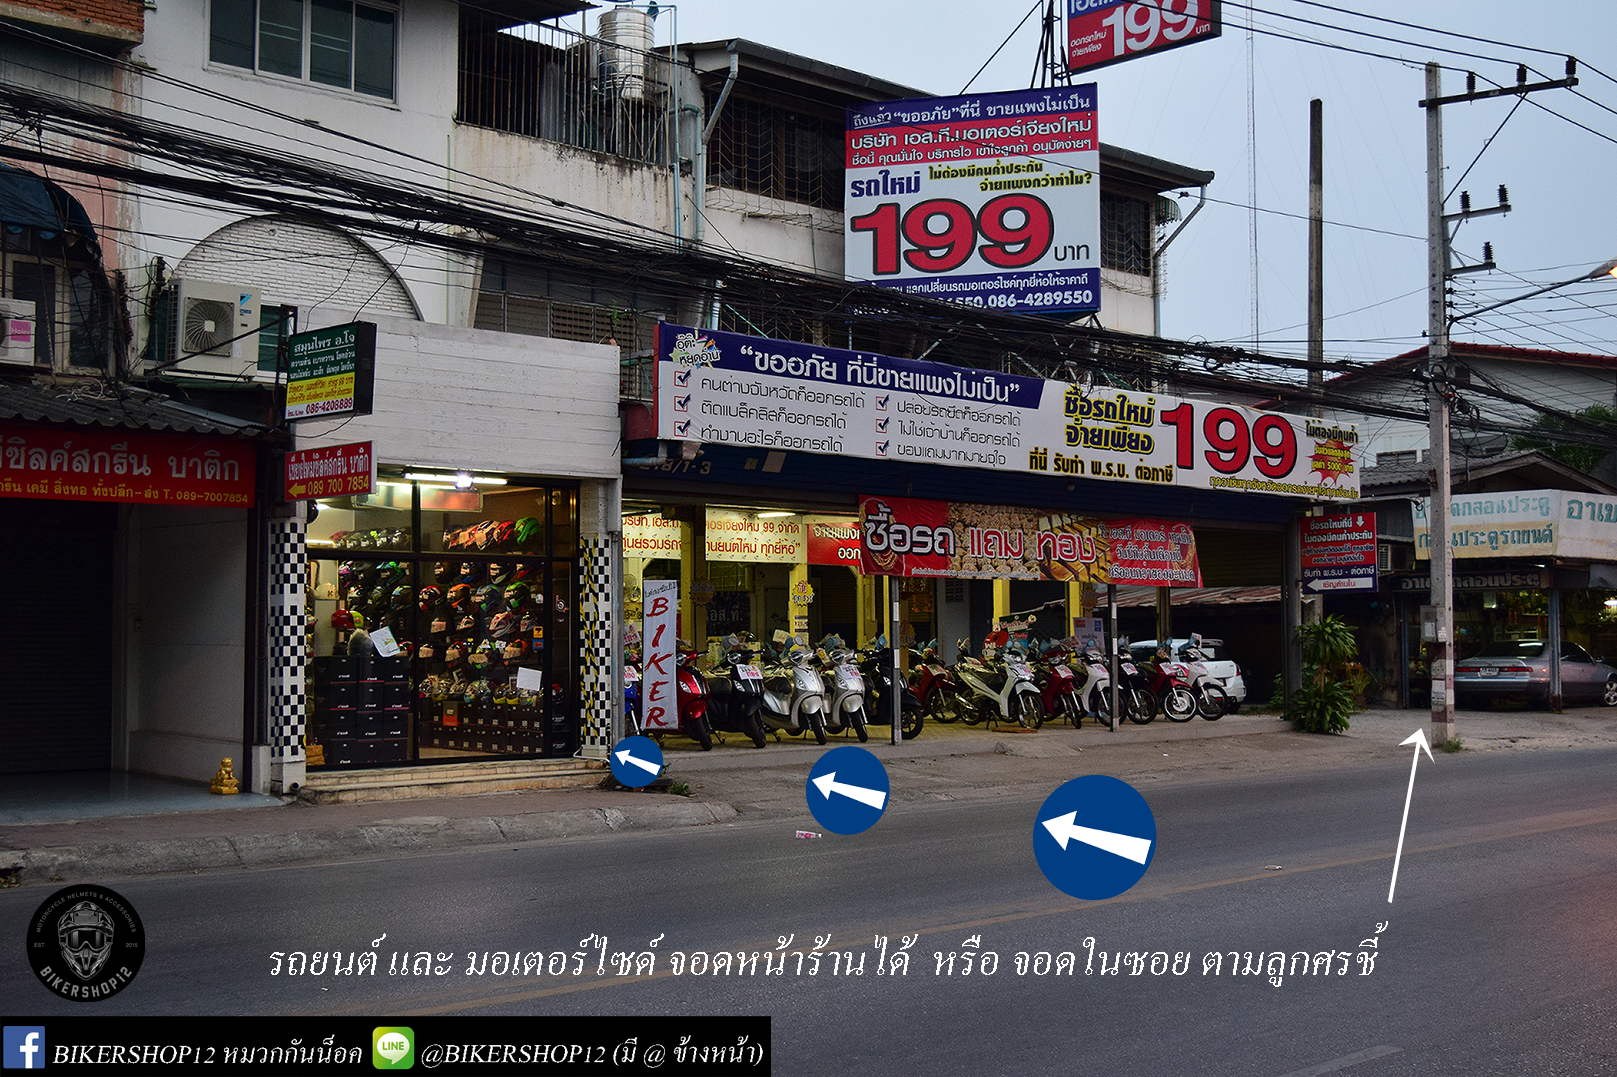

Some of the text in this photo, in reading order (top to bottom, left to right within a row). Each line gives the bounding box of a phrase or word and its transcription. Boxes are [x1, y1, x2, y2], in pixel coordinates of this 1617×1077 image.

[1102, 0, 1199, 57] 199
[851, 131, 897, 149] บริษัท
[927, 144, 972, 160] บริการไว
[850, 169, 921, 198] รถใหม่
[850, 193, 1090, 275] 199 บาท
[1063, 385, 1156, 428] ซื้อรถใหม่
[1064, 417, 1156, 454] จ่ายเพียง
[1160, 402, 1297, 479] 199
[0, 434, 240, 481] ซิลค์สกรีน บาติก
[1029, 447, 1173, 483] ที่นี่ รับทำ พ.ร.บ. ต่อภาษี
[26, 480, 49, 494] เคมี
[53, 477, 87, 497] สิ่งทอ
[163, 489, 174, 500] T.
[176, 491, 248, 503] 089-7007854
[308, 475, 369, 496] 089 700 7854
[763, 521, 774, 533] 99
[778, 518, 800, 535] จำกัด
[865, 502, 1097, 564] ซื้อรถ แถม ทอง
[644, 596, 672, 727] BIKER
